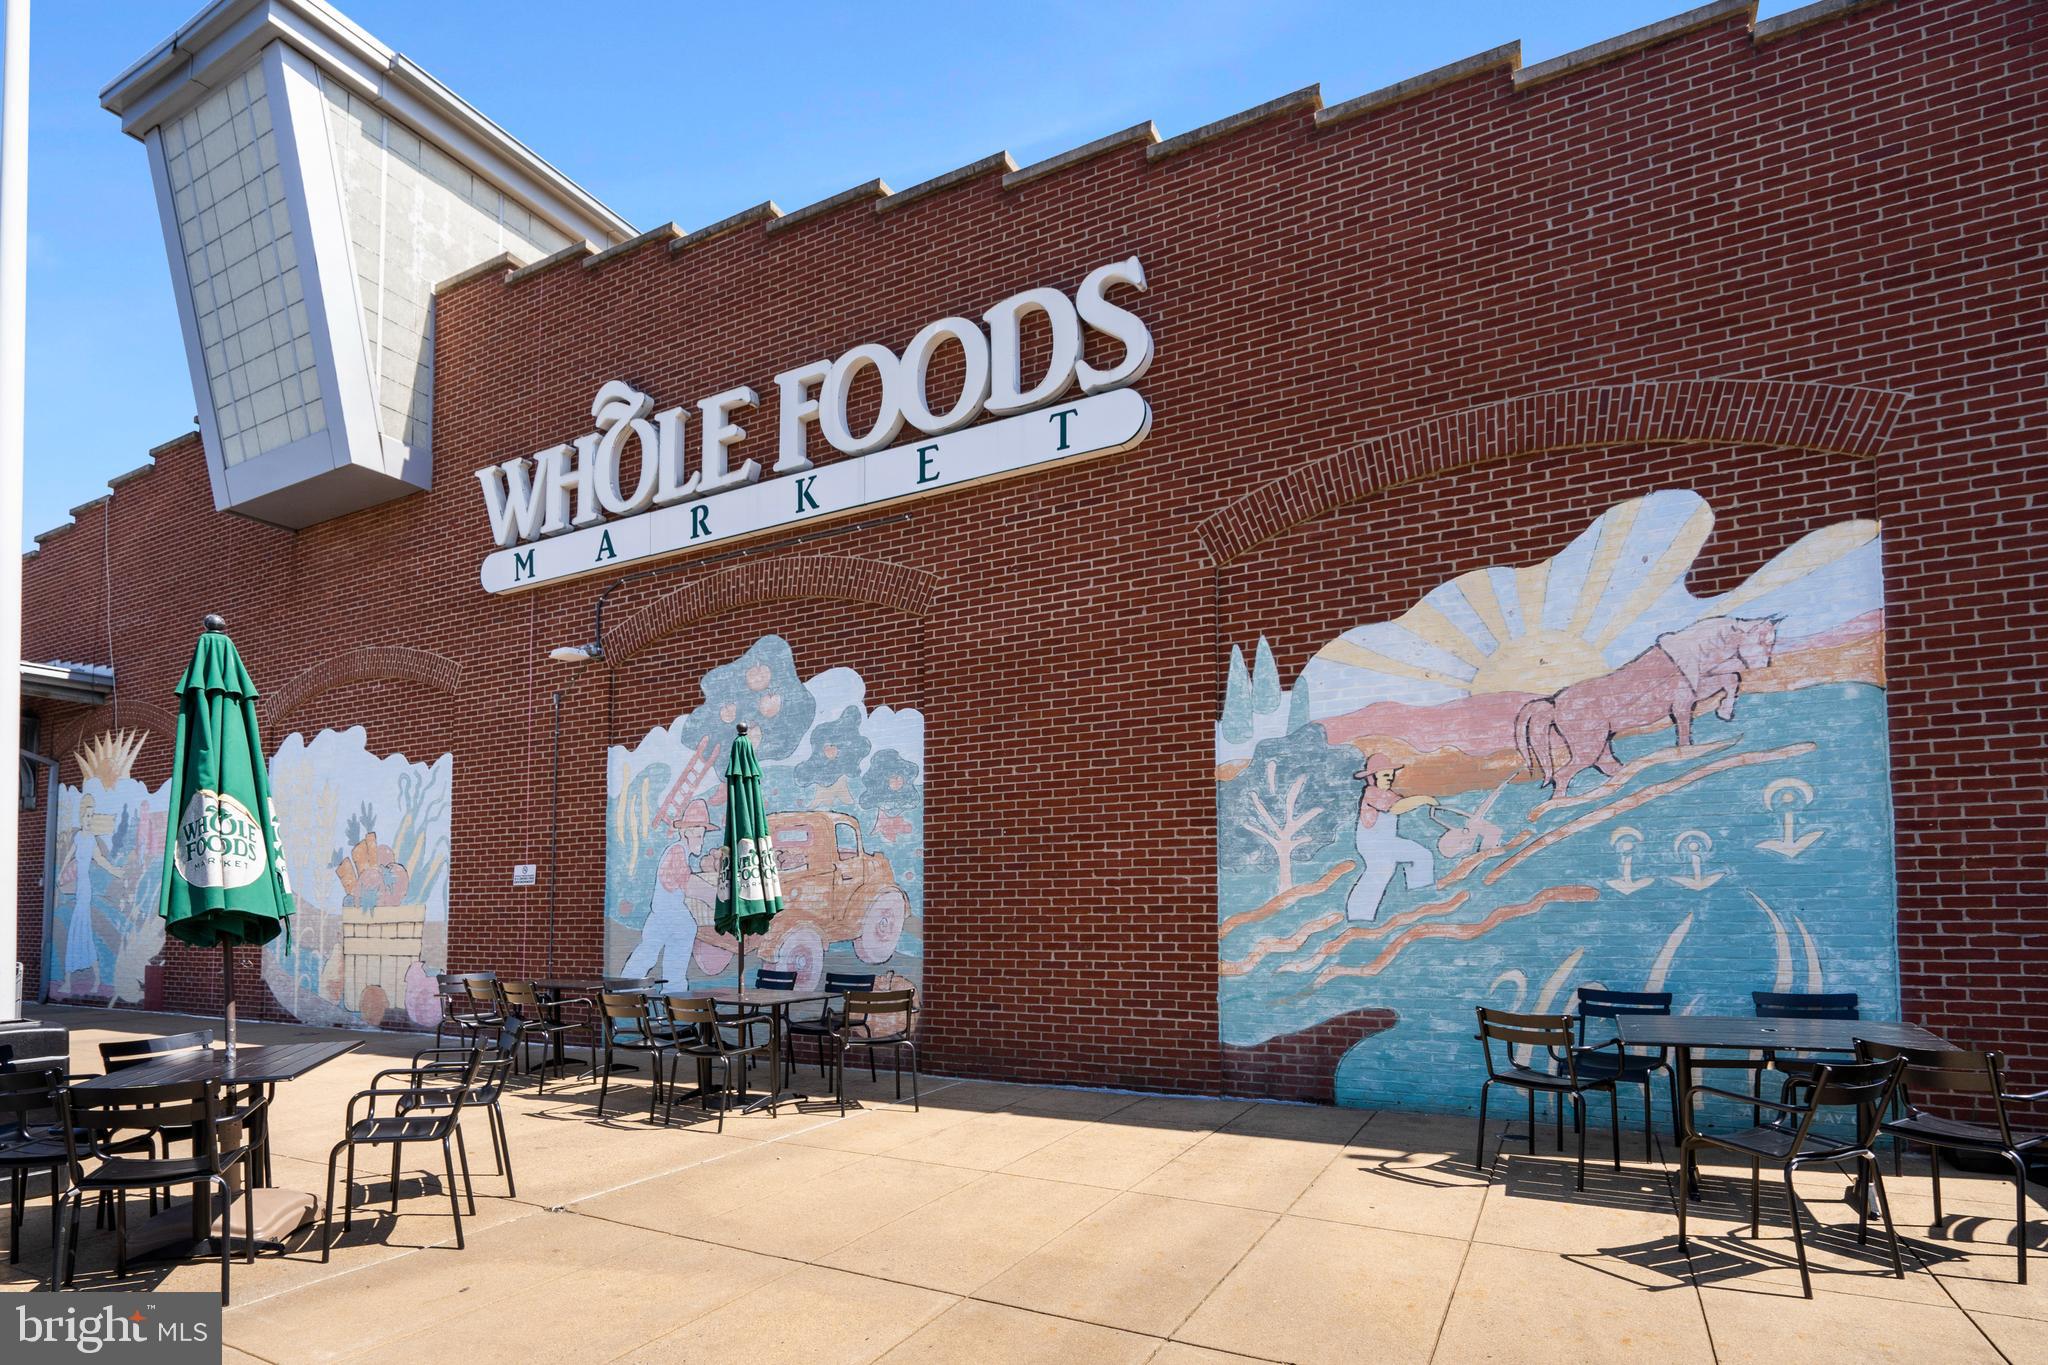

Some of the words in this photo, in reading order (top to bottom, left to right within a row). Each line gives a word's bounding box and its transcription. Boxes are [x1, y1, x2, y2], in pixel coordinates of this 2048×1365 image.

[474, 380, 762, 548] WHOLE
[772, 255, 1155, 474] FOODS
[513, 408, 1080, 582] MARKET
[183, 805, 257, 843] WHOLE
[186, 834, 257, 862] FOODS
[195, 857, 248, 872] MARKET
